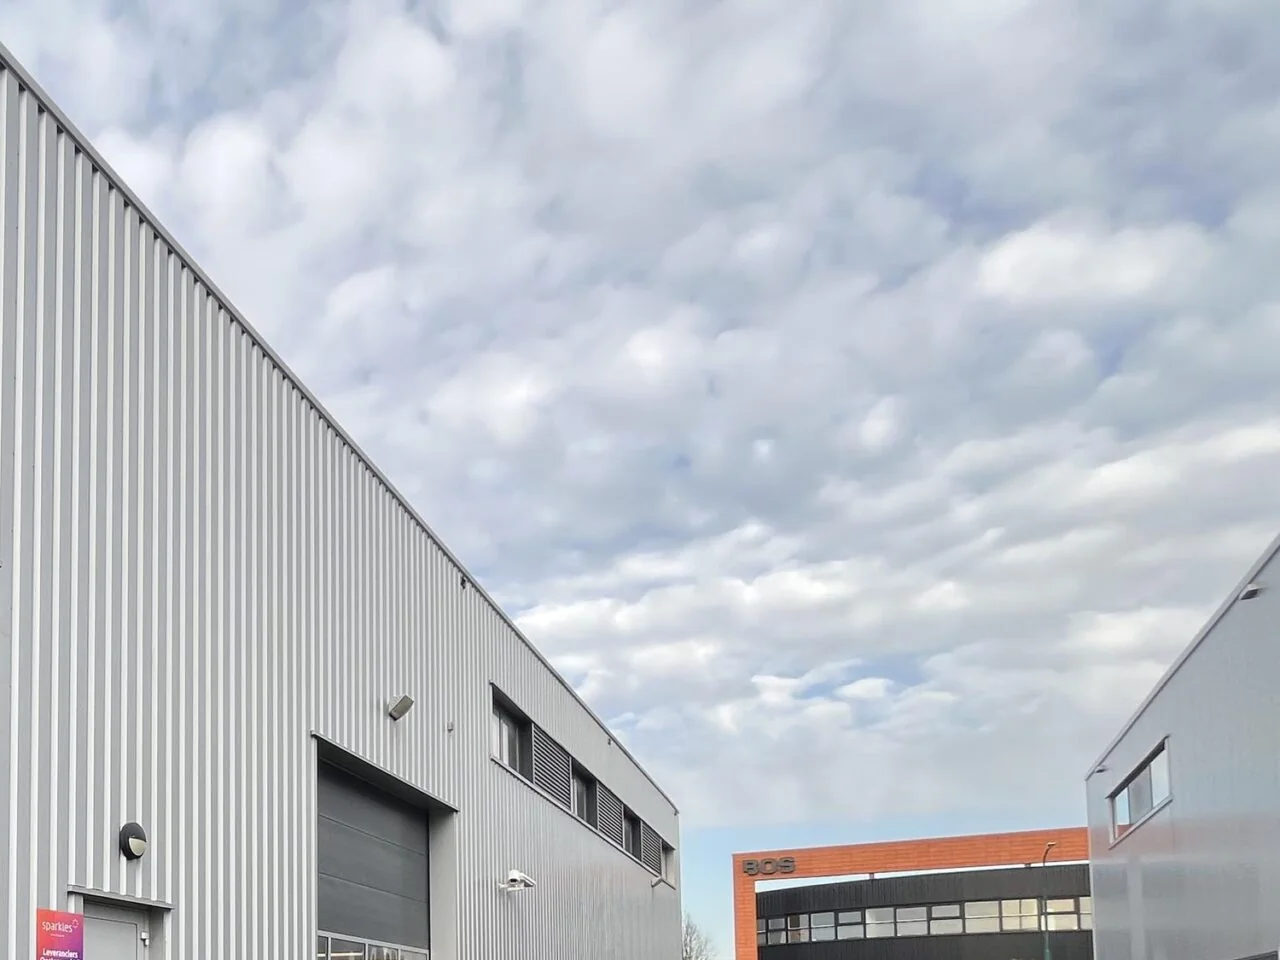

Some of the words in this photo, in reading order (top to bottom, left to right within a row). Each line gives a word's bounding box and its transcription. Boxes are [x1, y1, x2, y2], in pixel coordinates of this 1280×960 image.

[742, 857, 796, 876] BOS
[42, 921, 73, 933] sparkles
[42, 948, 78, 958] Leveranciers
